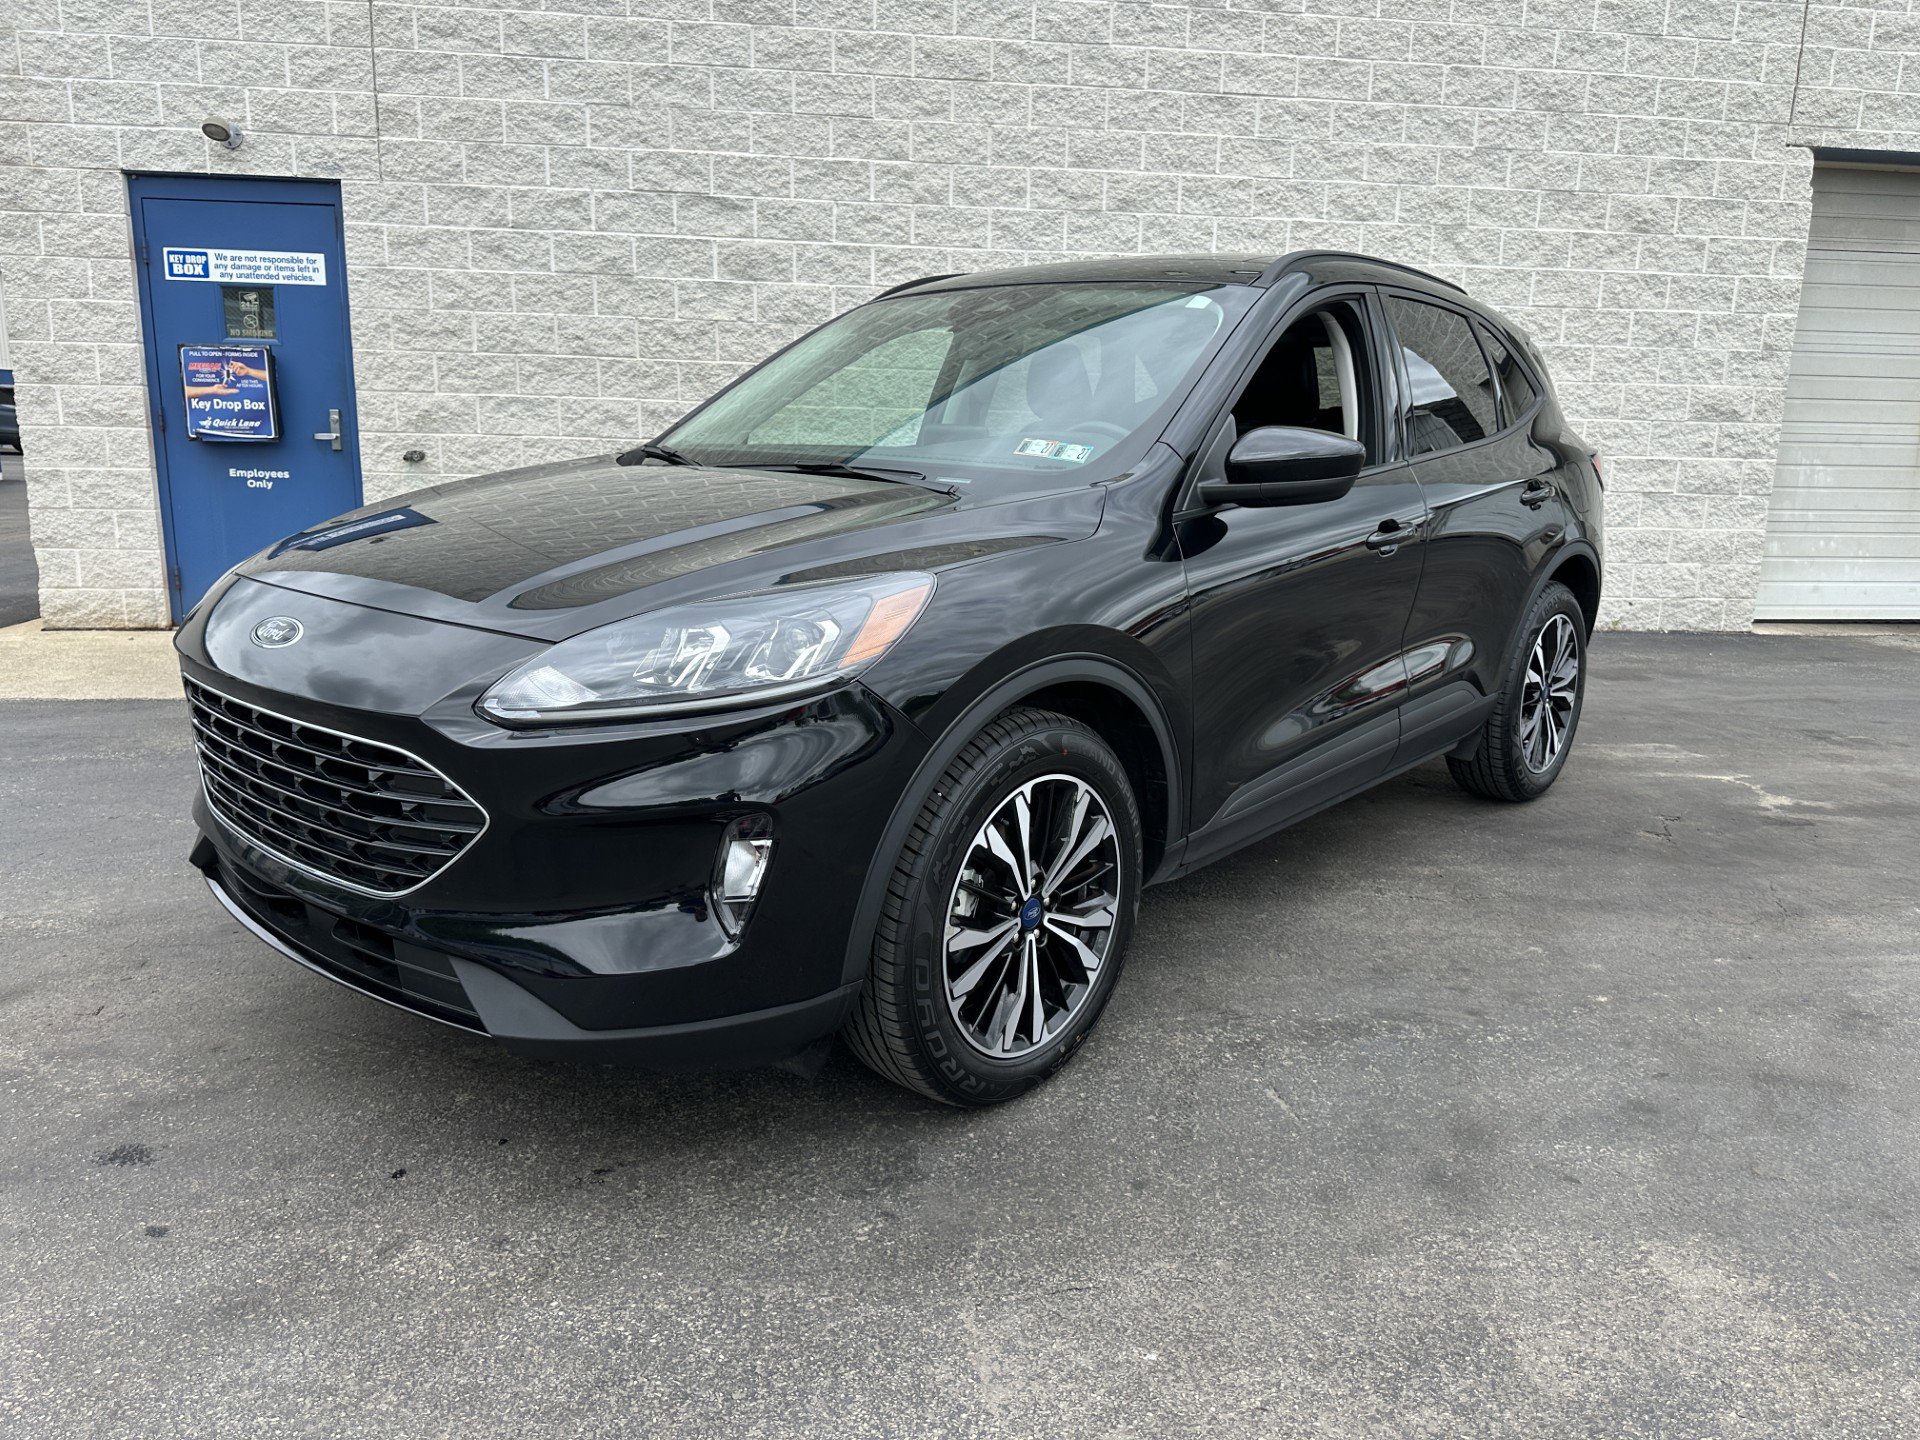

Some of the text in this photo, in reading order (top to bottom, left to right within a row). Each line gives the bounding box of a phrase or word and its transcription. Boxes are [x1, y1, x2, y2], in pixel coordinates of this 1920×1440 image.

[169, 254, 206, 264] KEY DROP
[214, 253, 228, 261] We
[244, 255, 258, 263] not
[259, 255, 304, 265] responsible
[306, 256, 317, 265] for
[172, 264, 204, 276] BOX
[230, 263, 262, 273] damage
[273, 264, 295, 272] items
[297, 264, 311, 273] left
[312, 265, 319, 273] in
[219, 271, 316, 282] any unattended vehicles.
[242, 329, 273, 337] SMOKING
[191, 398, 266, 412] Key Drop Box
[213, 419, 261, 427] Quick Lane
[229, 468, 290, 479] Employees
[247, 479, 273, 489] Only
[258, 620, 290, 640] Ford
